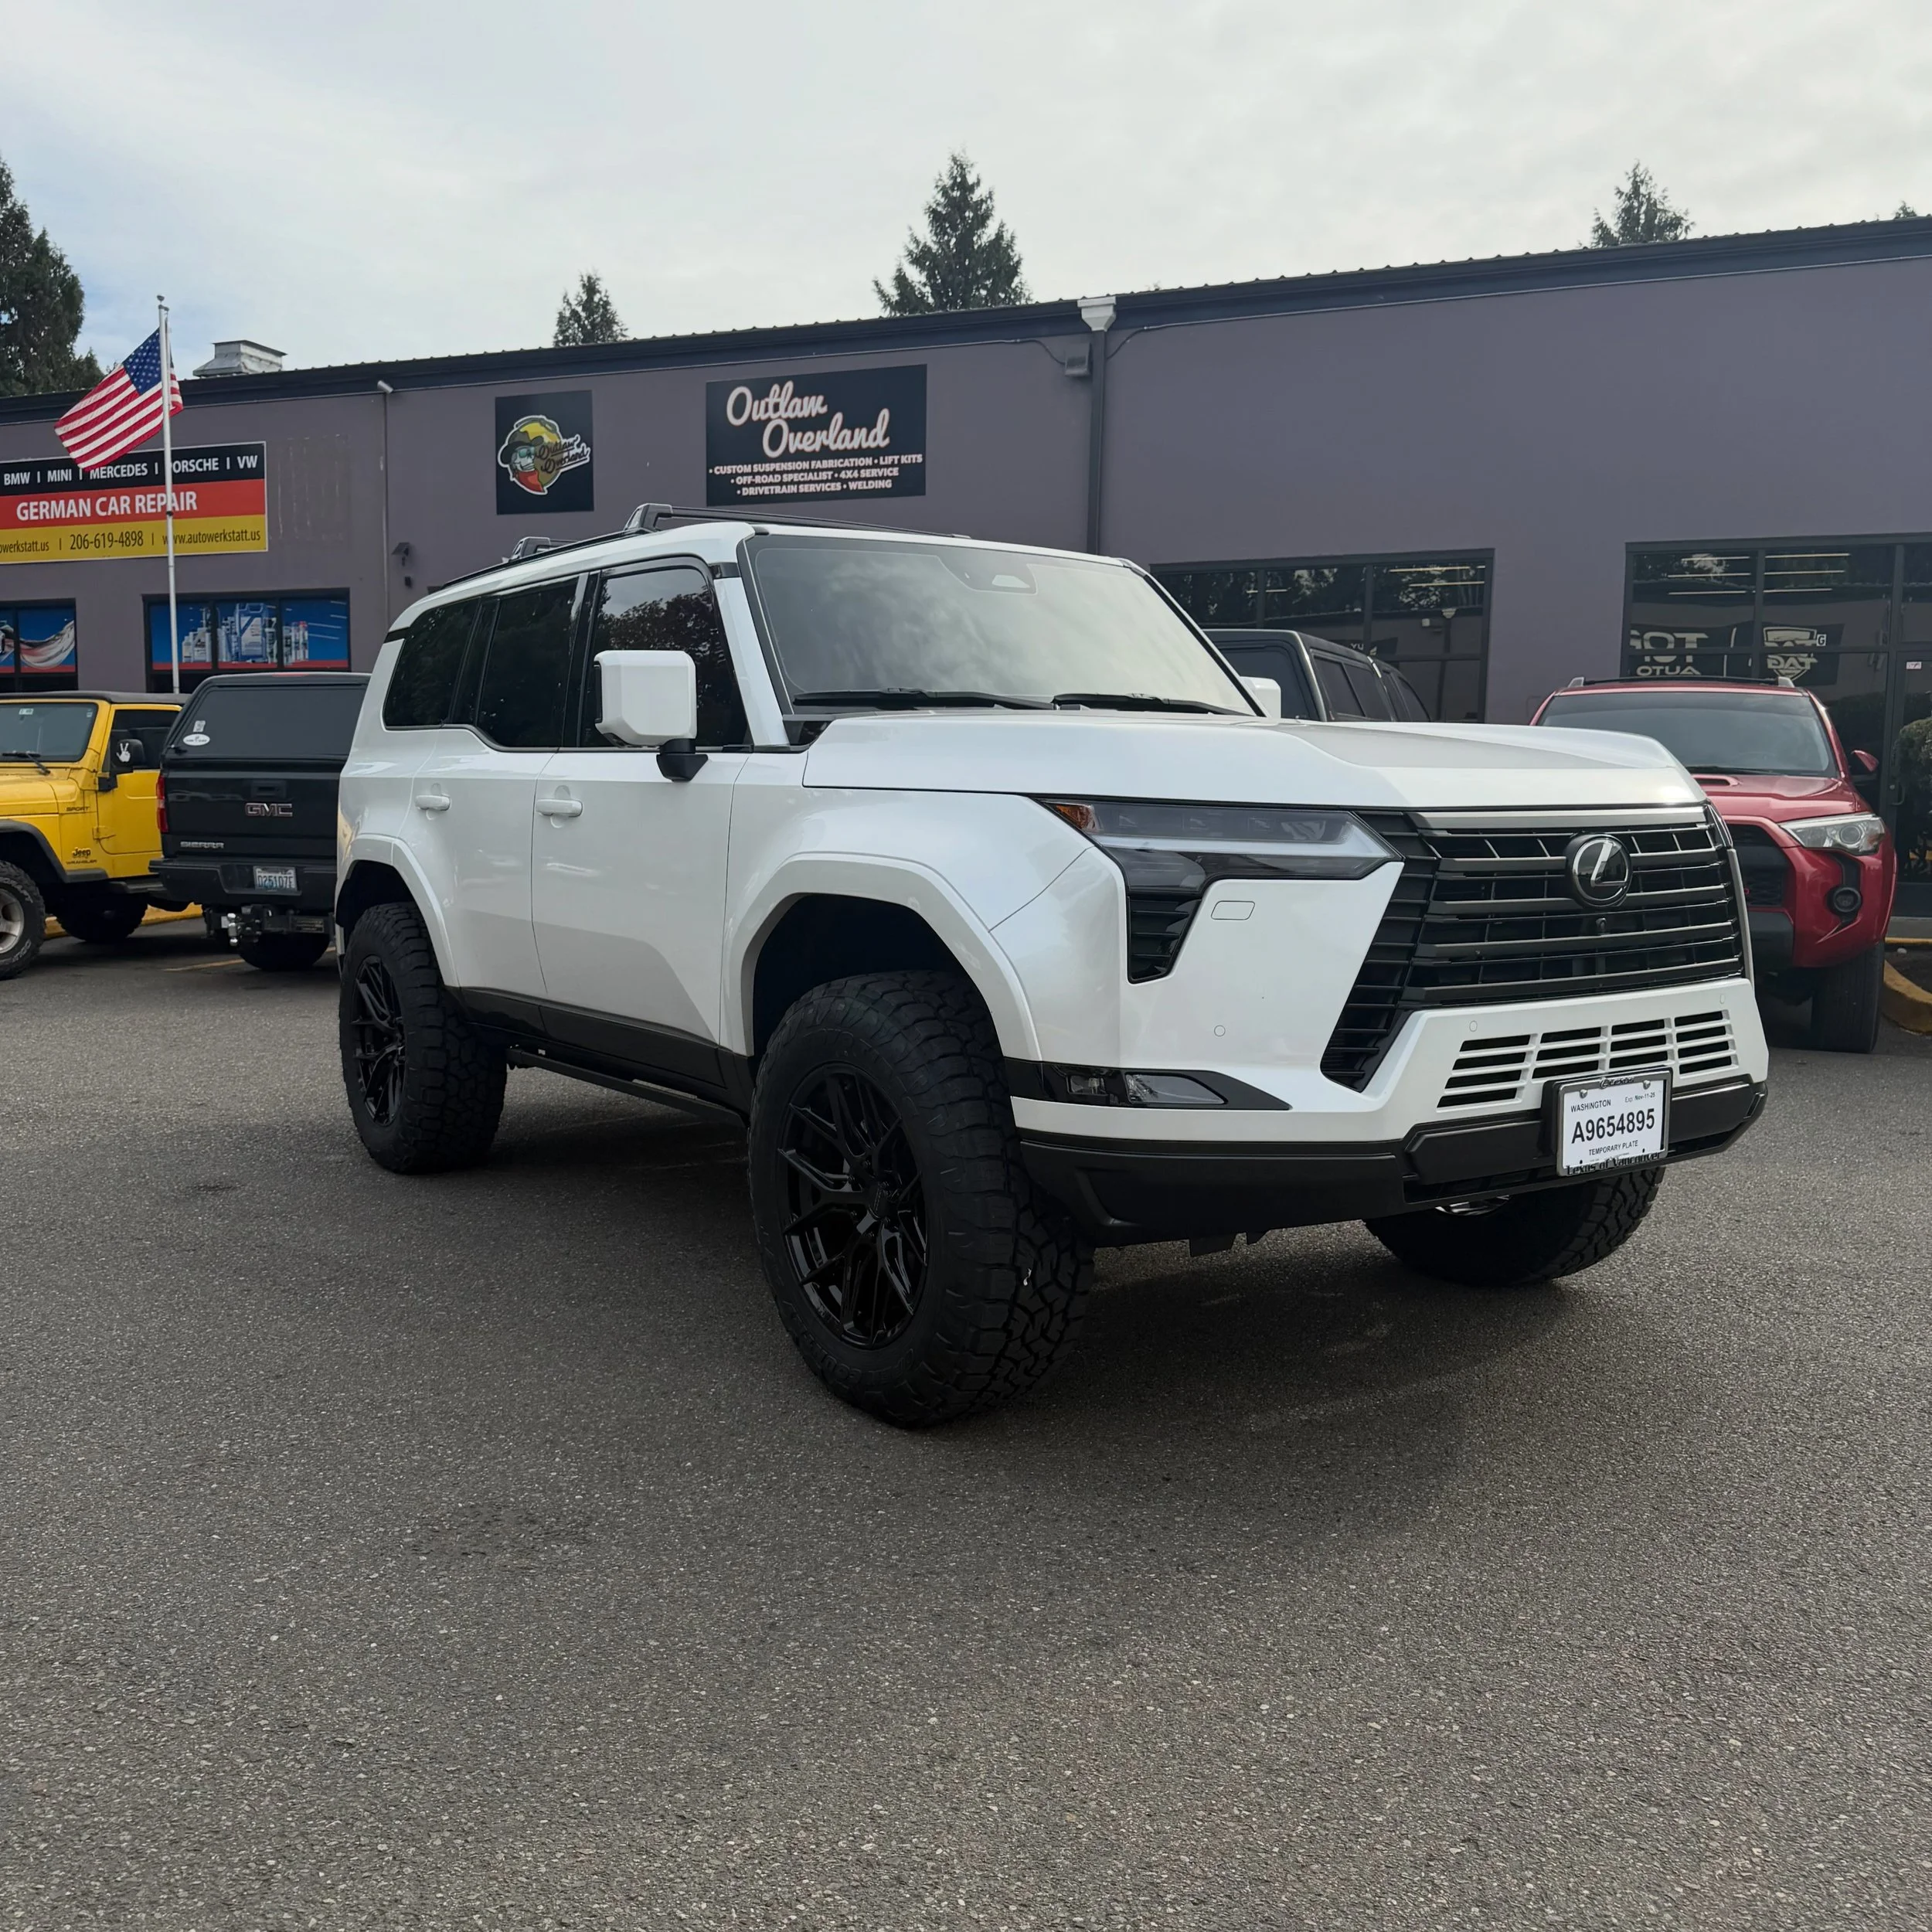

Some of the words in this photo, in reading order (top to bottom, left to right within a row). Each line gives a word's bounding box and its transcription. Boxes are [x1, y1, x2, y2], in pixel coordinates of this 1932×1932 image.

[726, 380, 828, 426] Outlaw
[763, 408, 890, 458] Overland
[4, 471, 30, 486] BMW
[47, 468, 72, 483] MINI
[90, 463, 148, 480] MERCEDES
[170, 457, 219, 474] ORSCHE
[237, 455, 258, 468] VW
[714, 464, 752, 475] CUSTOM
[753, 461, 810, 473] SUSPENSION
[811, 458, 873, 470] FABRICATION
[879, 455, 900, 465] LIFT
[901, 454, 923, 464] KITS
[736, 474, 781, 485] OFF-ROAD
[782, 471, 834, 483] SPECIALIST
[839, 469, 859, 480] 4X4
[859, 467, 900, 478] SERVICE
[742, 485, 798, 496] DRIVETRAIN
[798, 481, 842, 493] SERVICES
[849, 479, 893, 490] WELDING
[16, 498, 91, 521] GERMAN
[95, 495, 131, 516] CAR
[134, 491, 198, 513] REPAIR
[70, 530, 144, 550] 206-619-4898
[245, 802, 293, 817] GMC
[72, 847, 91, 859] Jeep
[1570, 1099, 1611, 1113] WASHINGTON
[1571, 1108, 1655, 1144] A9654895
[1589, 1144, 1621, 1156] TEMPORARY
[1622, 1140, 1638, 1150] PLATE
[1566, 1165, 1596, 1175] Lexus
[1599, 1159, 1609, 1169] of
[1612, 1152, 1661, 1167] Vancouver
